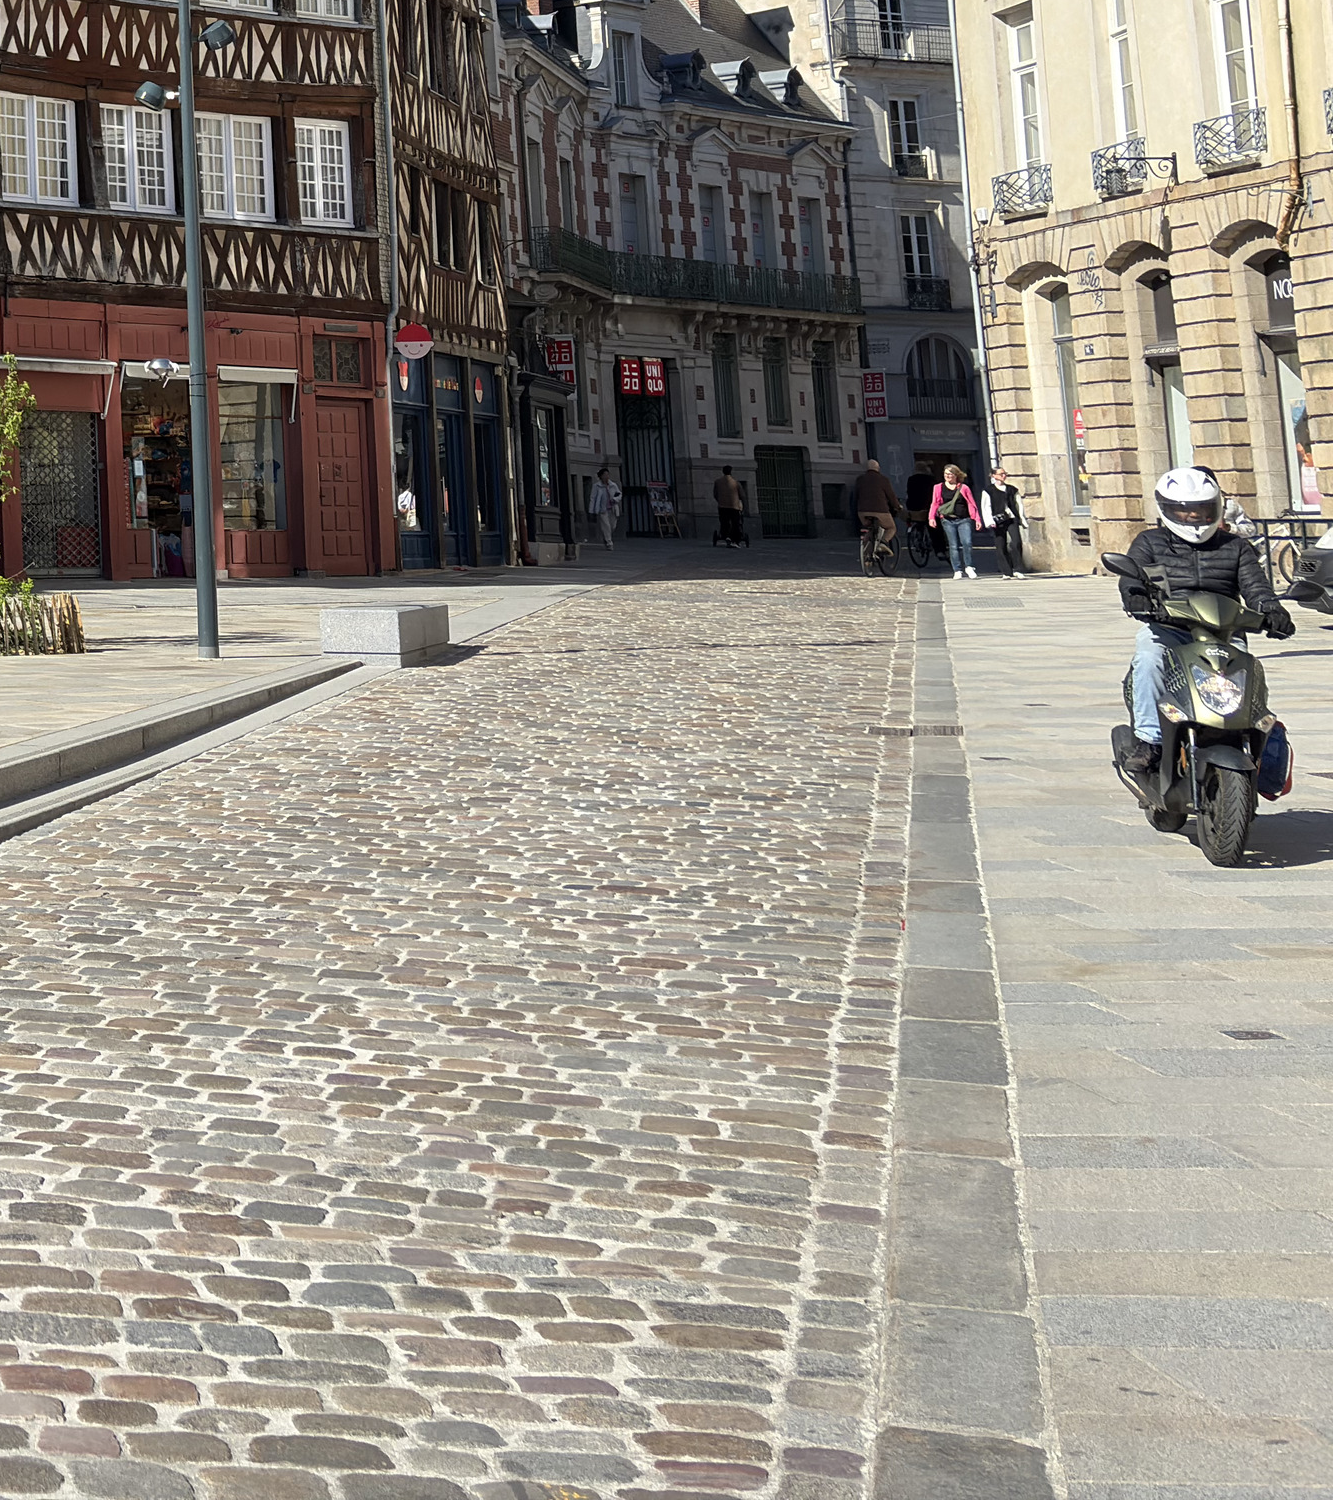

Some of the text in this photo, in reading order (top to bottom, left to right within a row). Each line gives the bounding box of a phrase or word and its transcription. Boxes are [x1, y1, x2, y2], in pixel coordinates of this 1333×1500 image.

[645, 365, 661, 378] UNI
[647, 379, 663, 392] QLO
[867, 399, 882, 407] UNI
[868, 407, 885, 416] QLO
